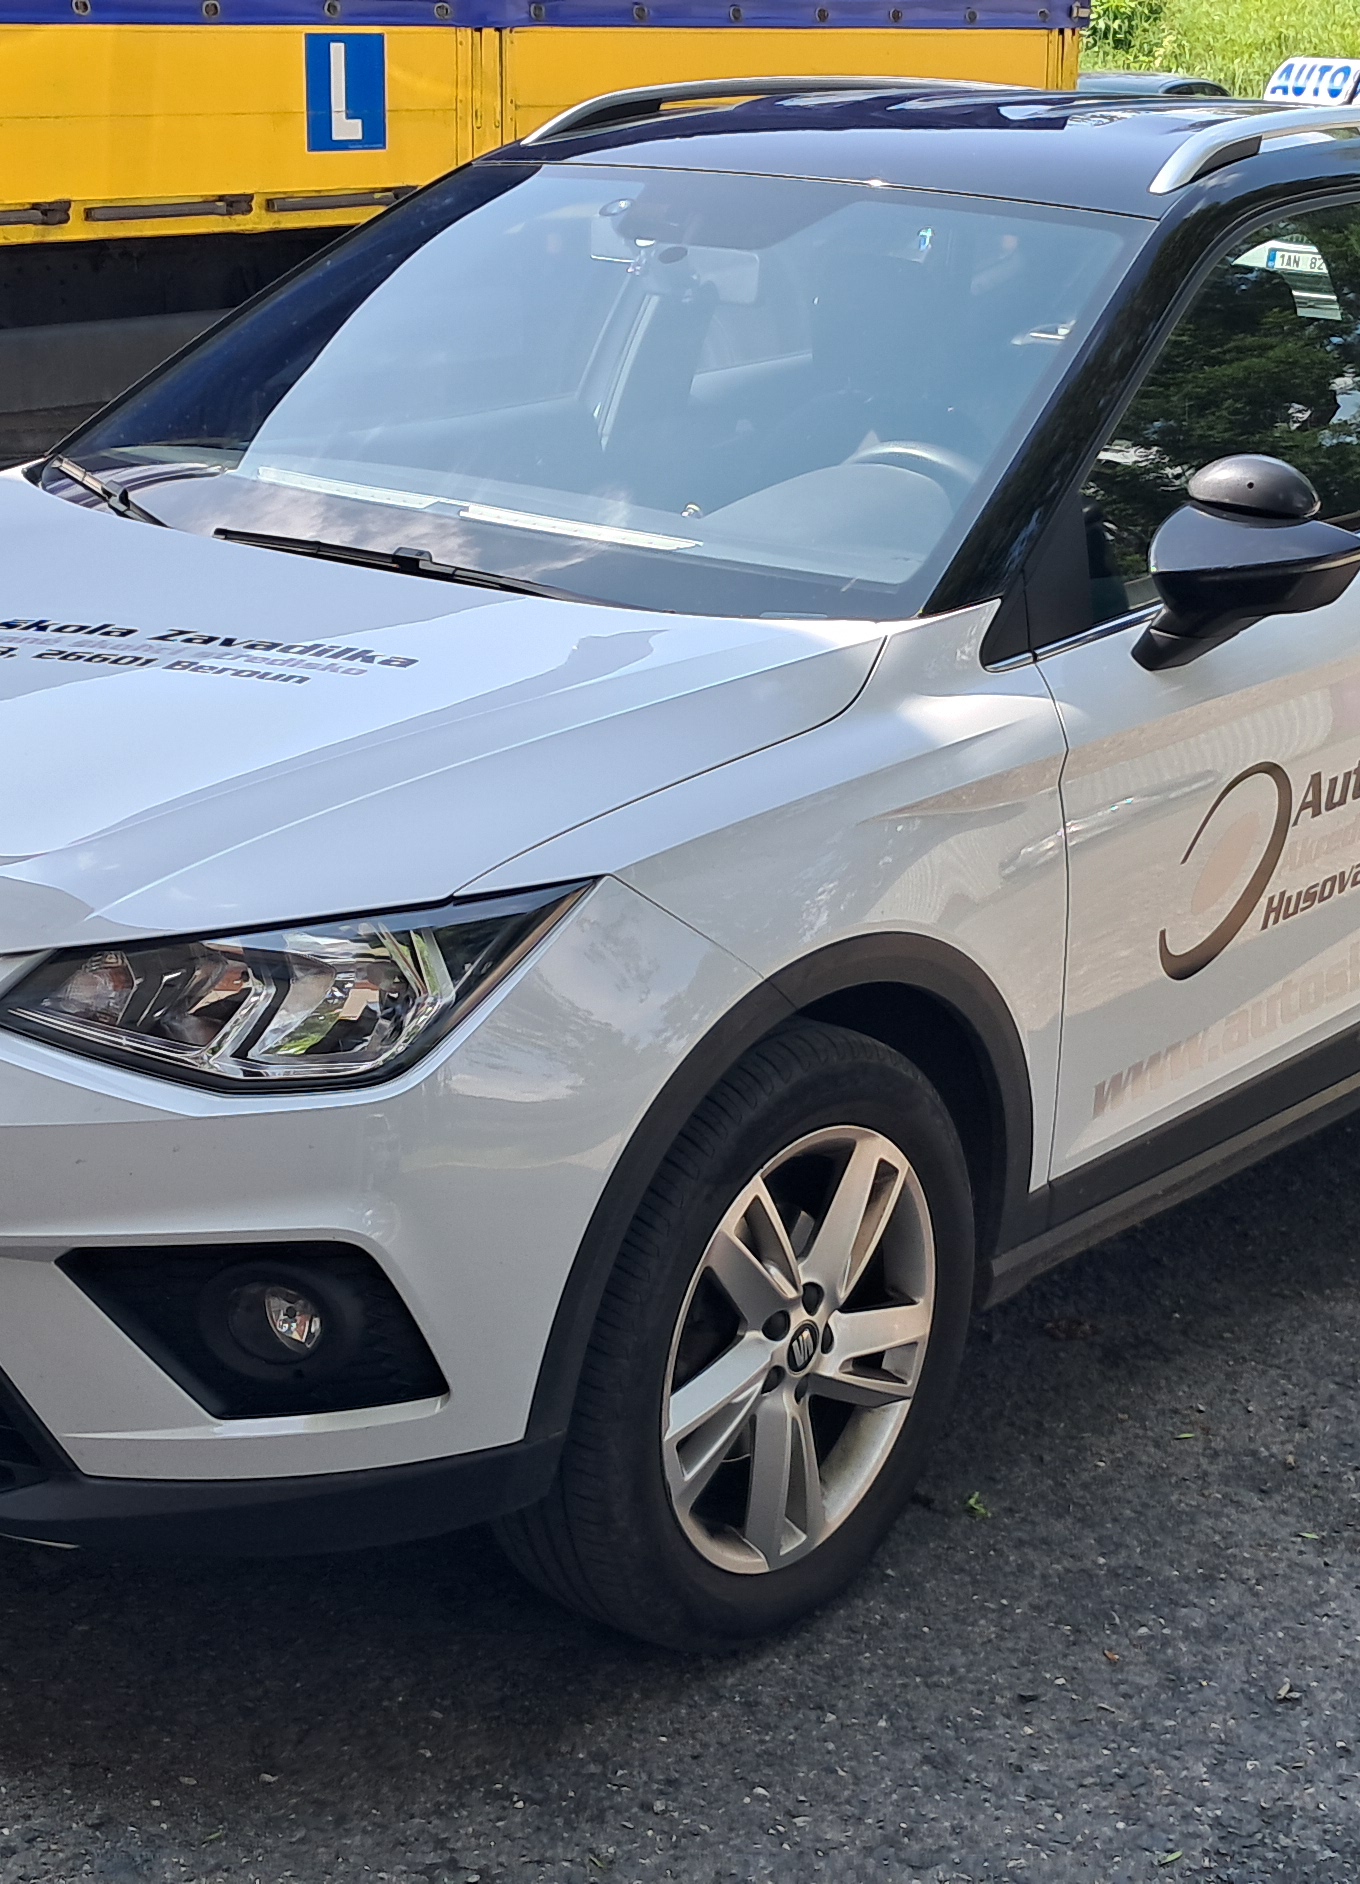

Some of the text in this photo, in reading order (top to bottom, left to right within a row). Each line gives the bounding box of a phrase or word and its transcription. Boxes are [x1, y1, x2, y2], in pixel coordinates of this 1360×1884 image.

[329, 41, 363, 141] L
[1280, 253, 1301, 269] 1AN
[31, 648, 159, 667] 26601
[161, 660, 312, 685] Beroun
[146, 628, 420, 669] Zavadilka
